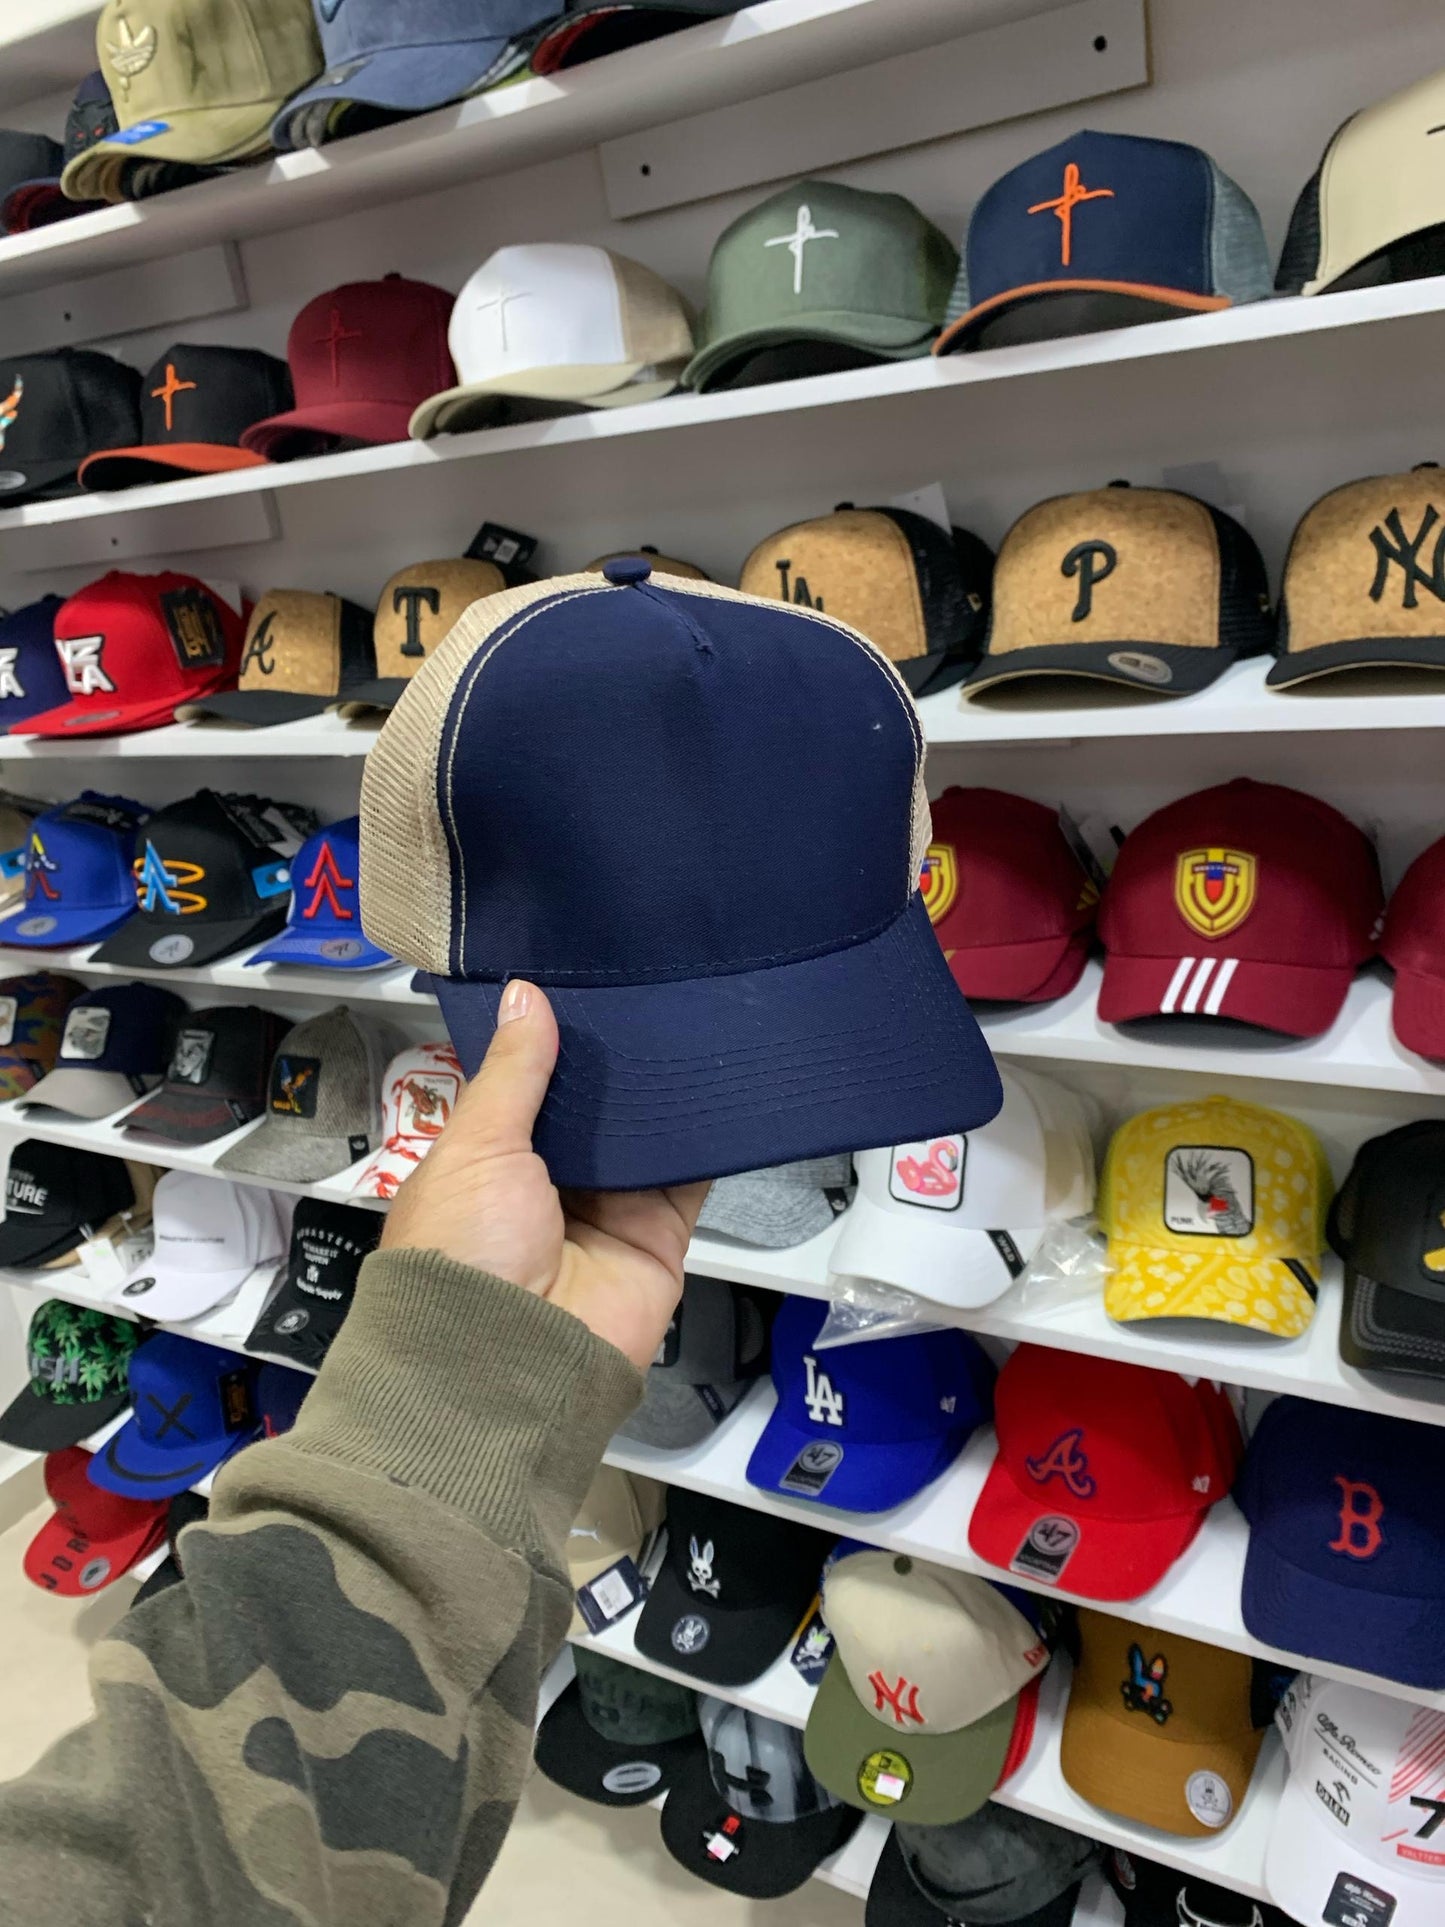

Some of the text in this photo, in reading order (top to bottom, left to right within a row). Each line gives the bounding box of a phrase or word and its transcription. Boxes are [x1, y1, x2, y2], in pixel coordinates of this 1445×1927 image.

[1061, 539, 1117, 622] P
[1368, 503, 1445, 609] NY
[240, 610, 277, 676] A
[393, 587, 440, 657] T
[6, 1180, 48, 1207] TURE
[803, 1356, 843, 1426] LA
[1025, 1427, 1098, 1499] A
[1328, 1474, 1385, 1558] B
[867, 1670, 926, 1726] NY
[1323, 1747, 1358, 1785] RACING
[1410, 1795, 1445, 1839] 7
